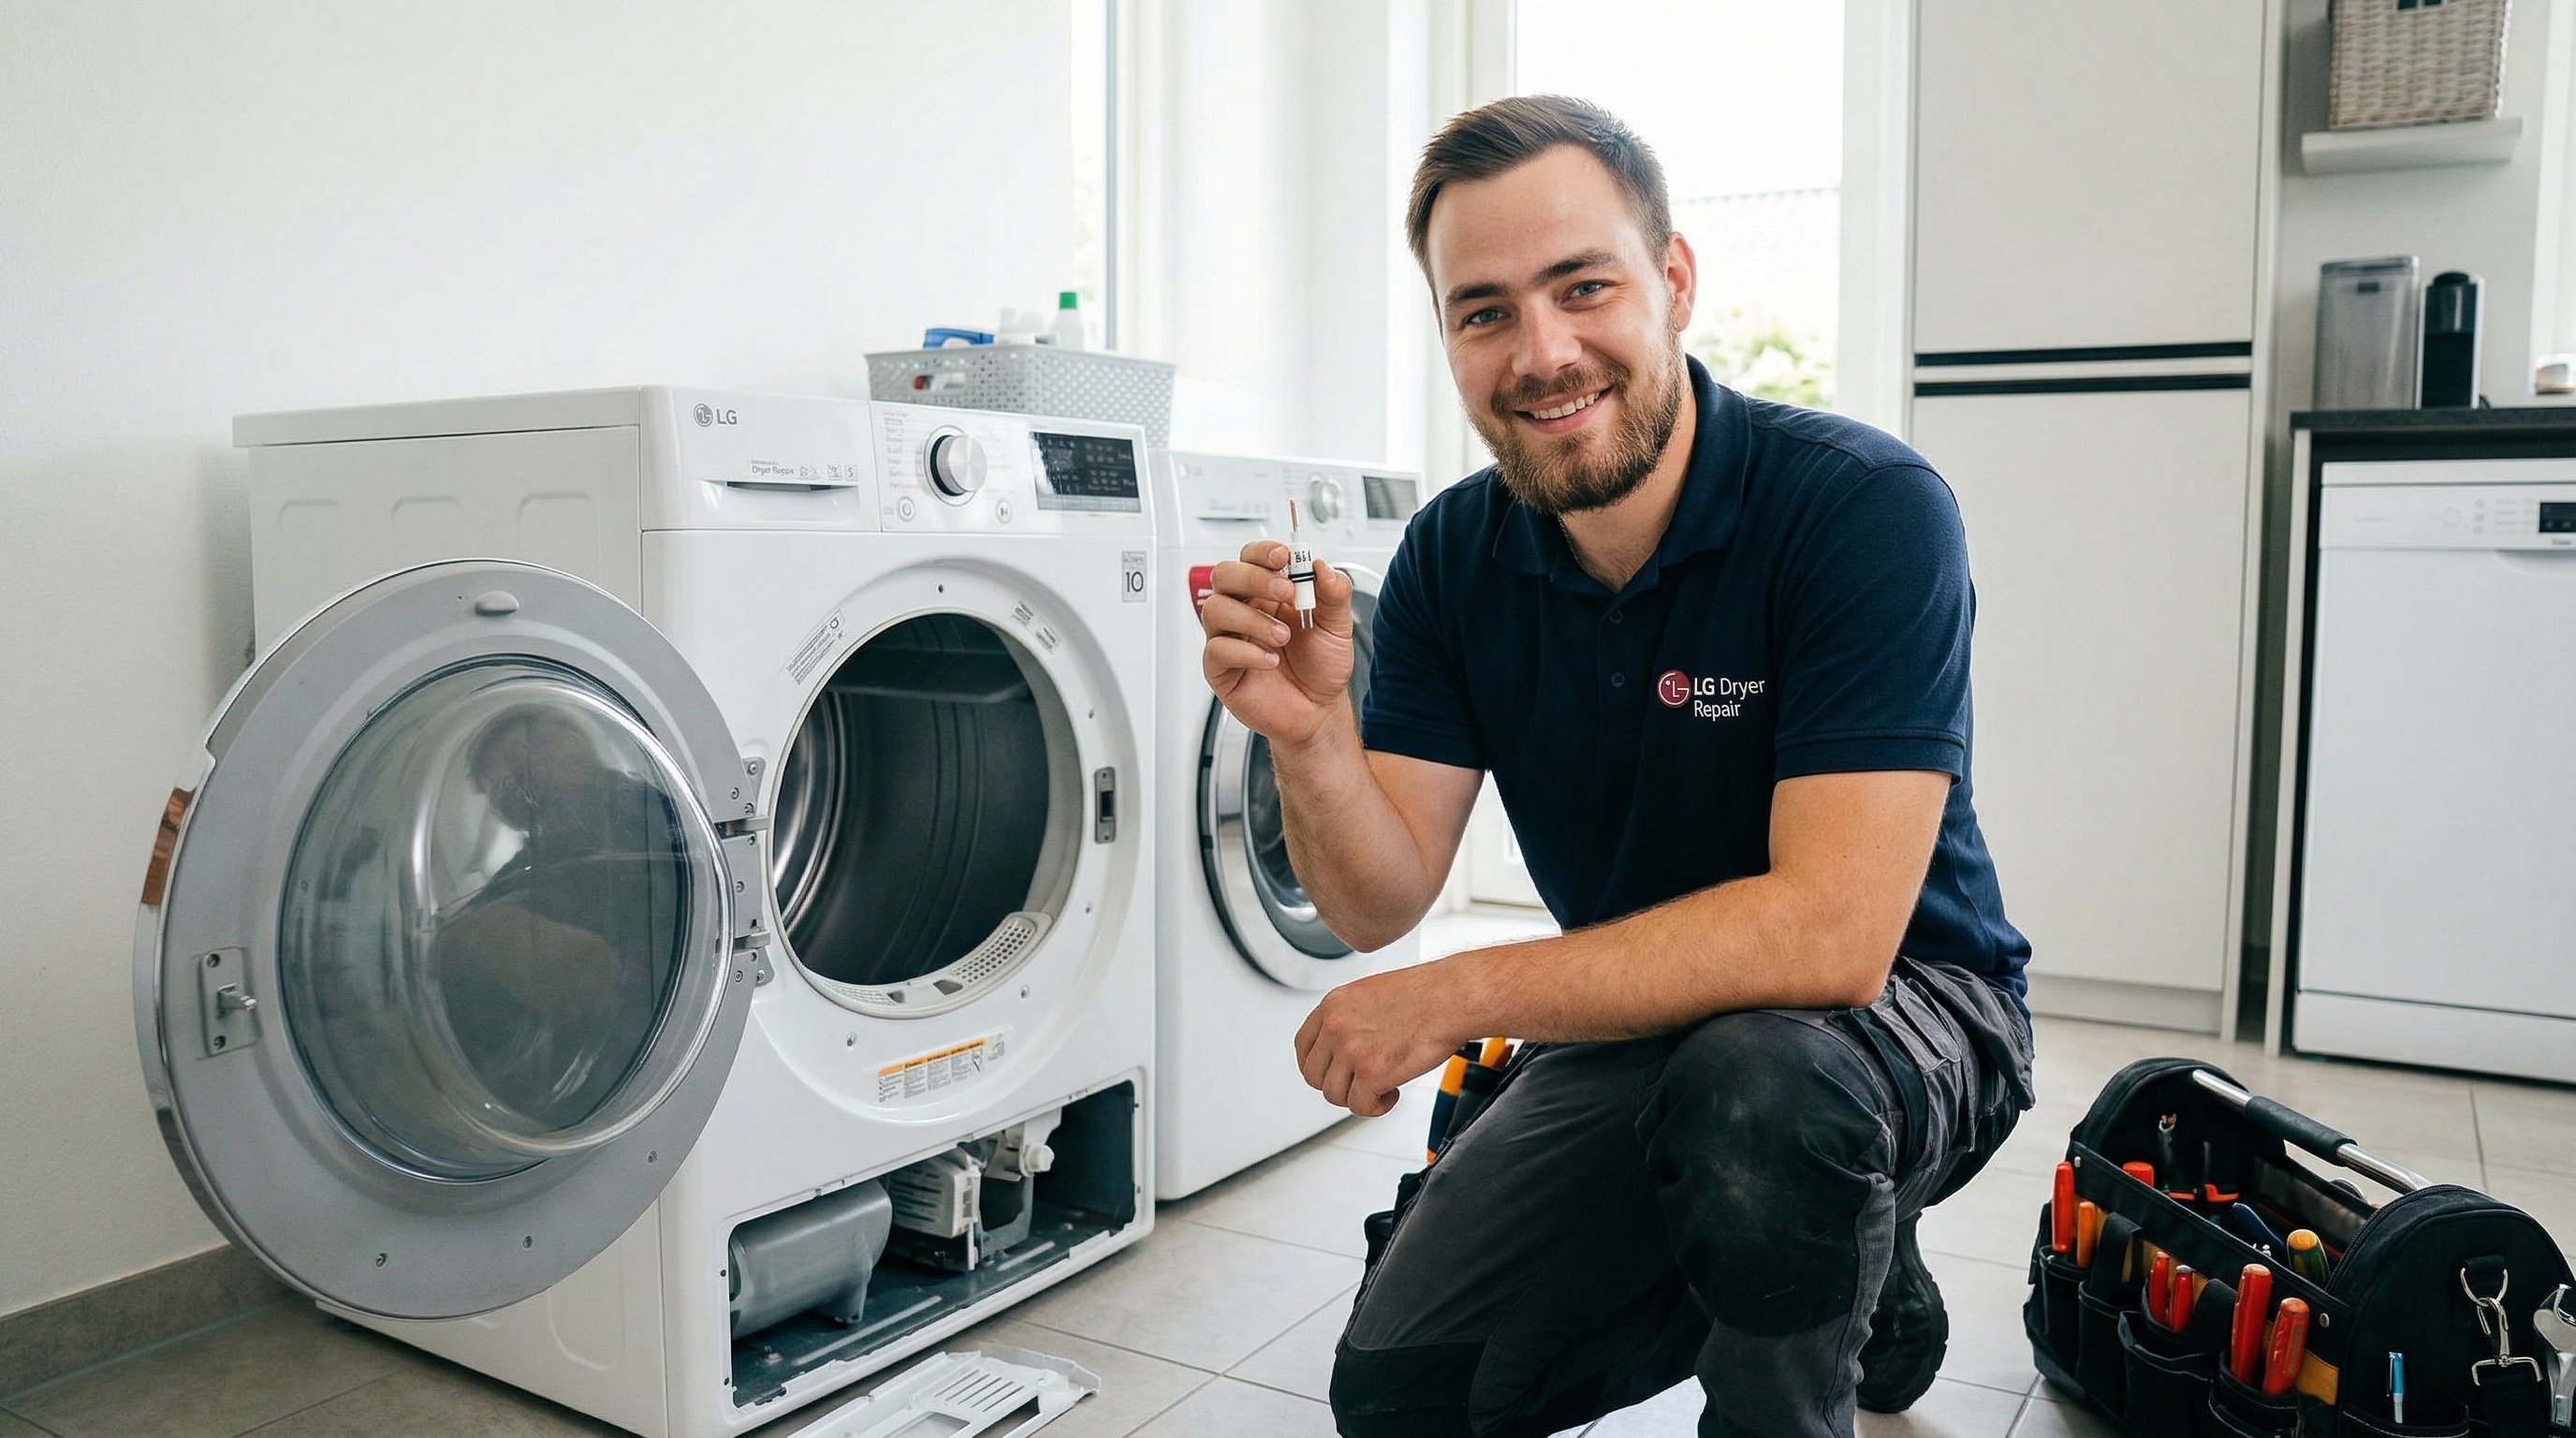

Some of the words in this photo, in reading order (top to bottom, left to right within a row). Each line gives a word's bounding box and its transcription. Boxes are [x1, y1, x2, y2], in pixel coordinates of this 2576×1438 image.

[716, 409, 739, 425] LG
[1125, 570, 1144, 593] 10
[1693, 677, 1716, 696] LG
[1720, 677, 1765, 700] Dryer
[1693, 699, 1741, 722] Repair
